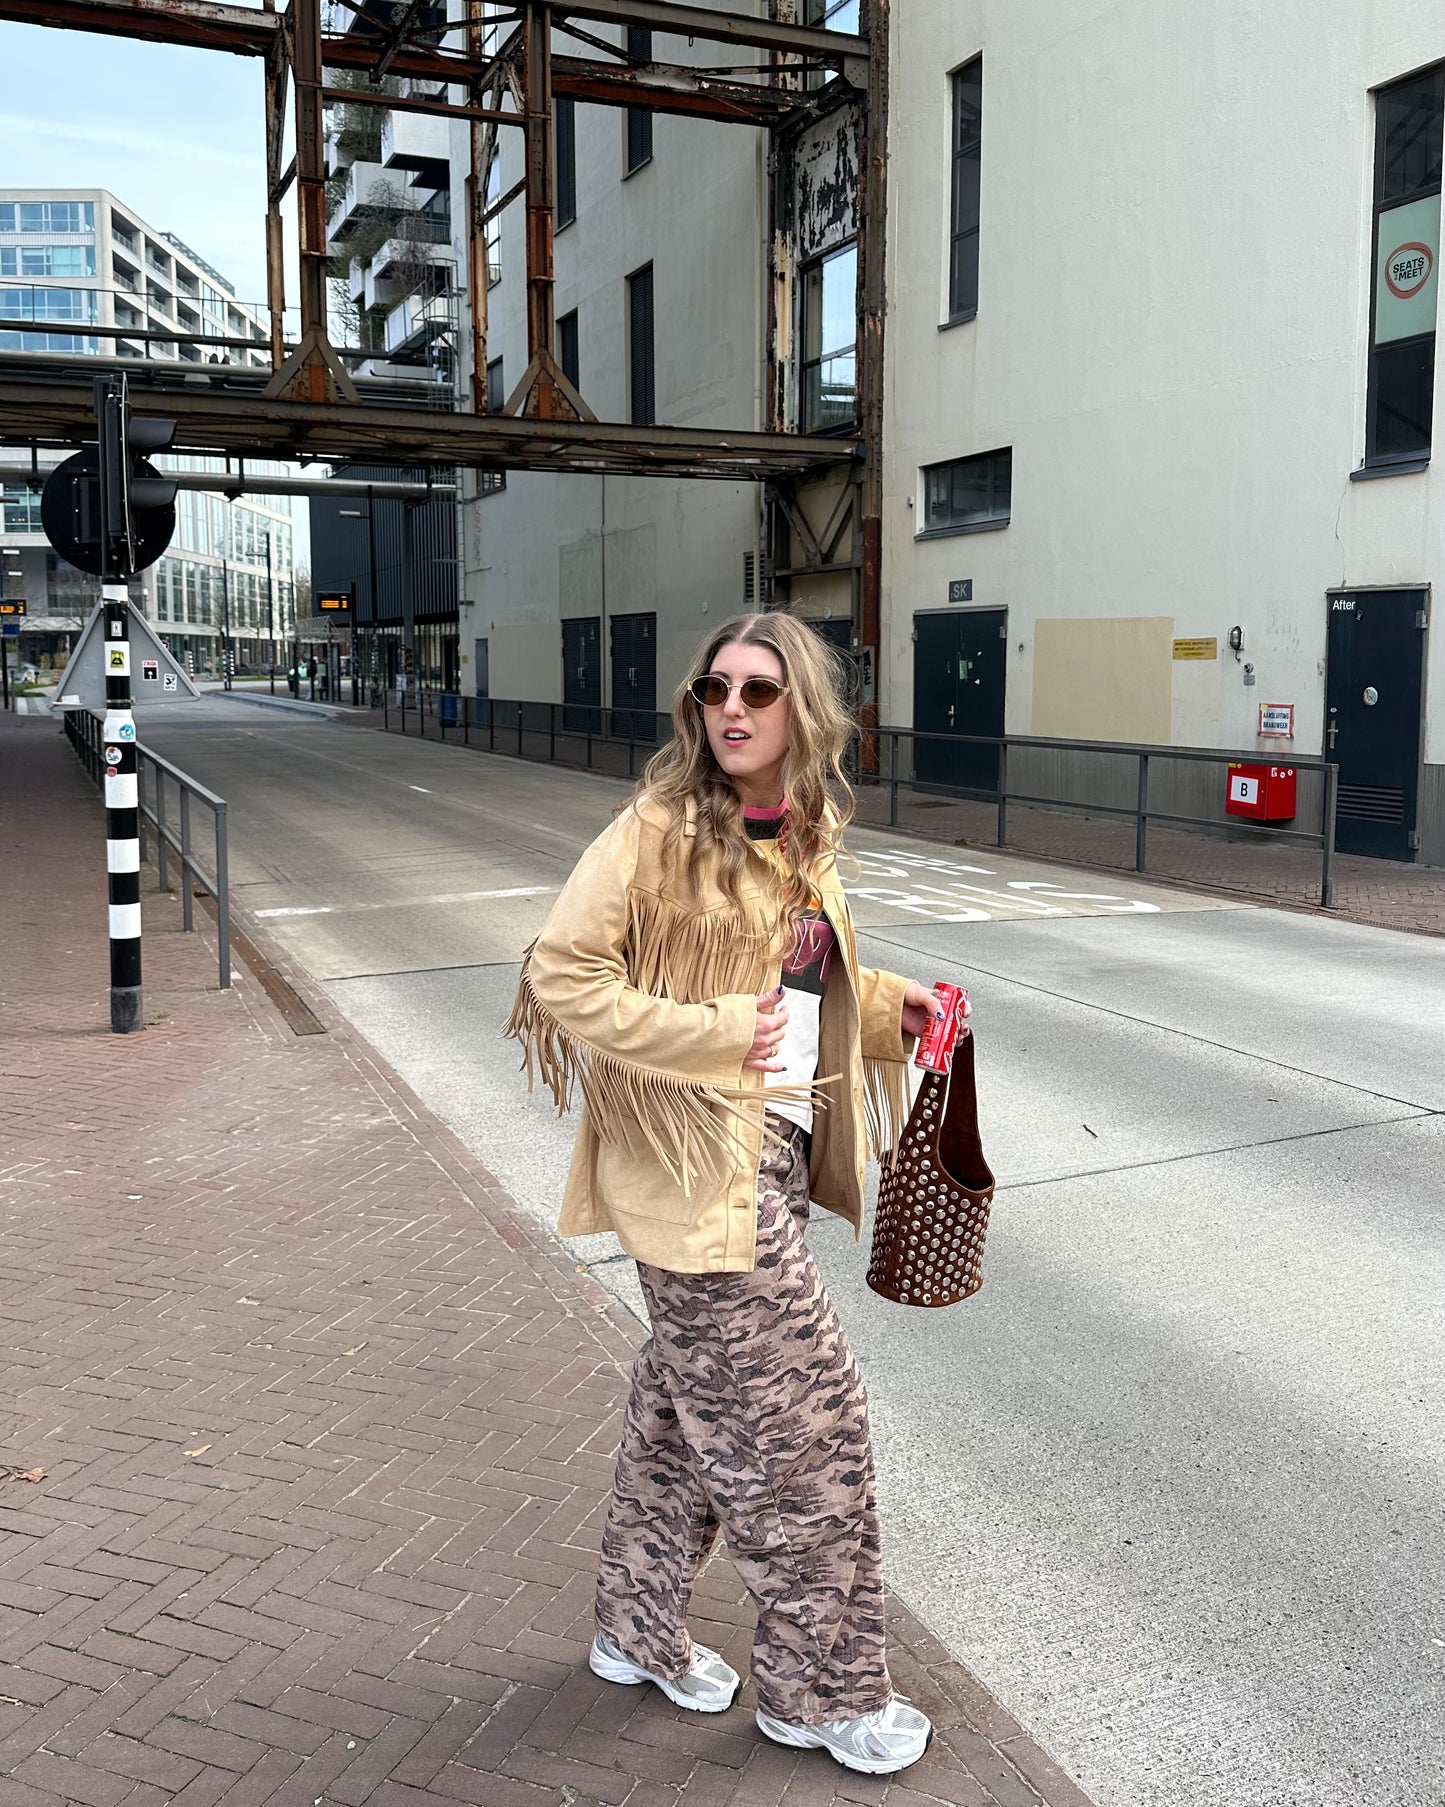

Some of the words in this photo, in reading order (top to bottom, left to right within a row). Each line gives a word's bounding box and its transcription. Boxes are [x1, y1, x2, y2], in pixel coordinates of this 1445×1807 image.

[1393, 257, 1425, 274] SEATS
[1332, 599, 1356, 611] After
[1240, 782, 1248, 797] B
[843, 881, 1161, 922] BUS
